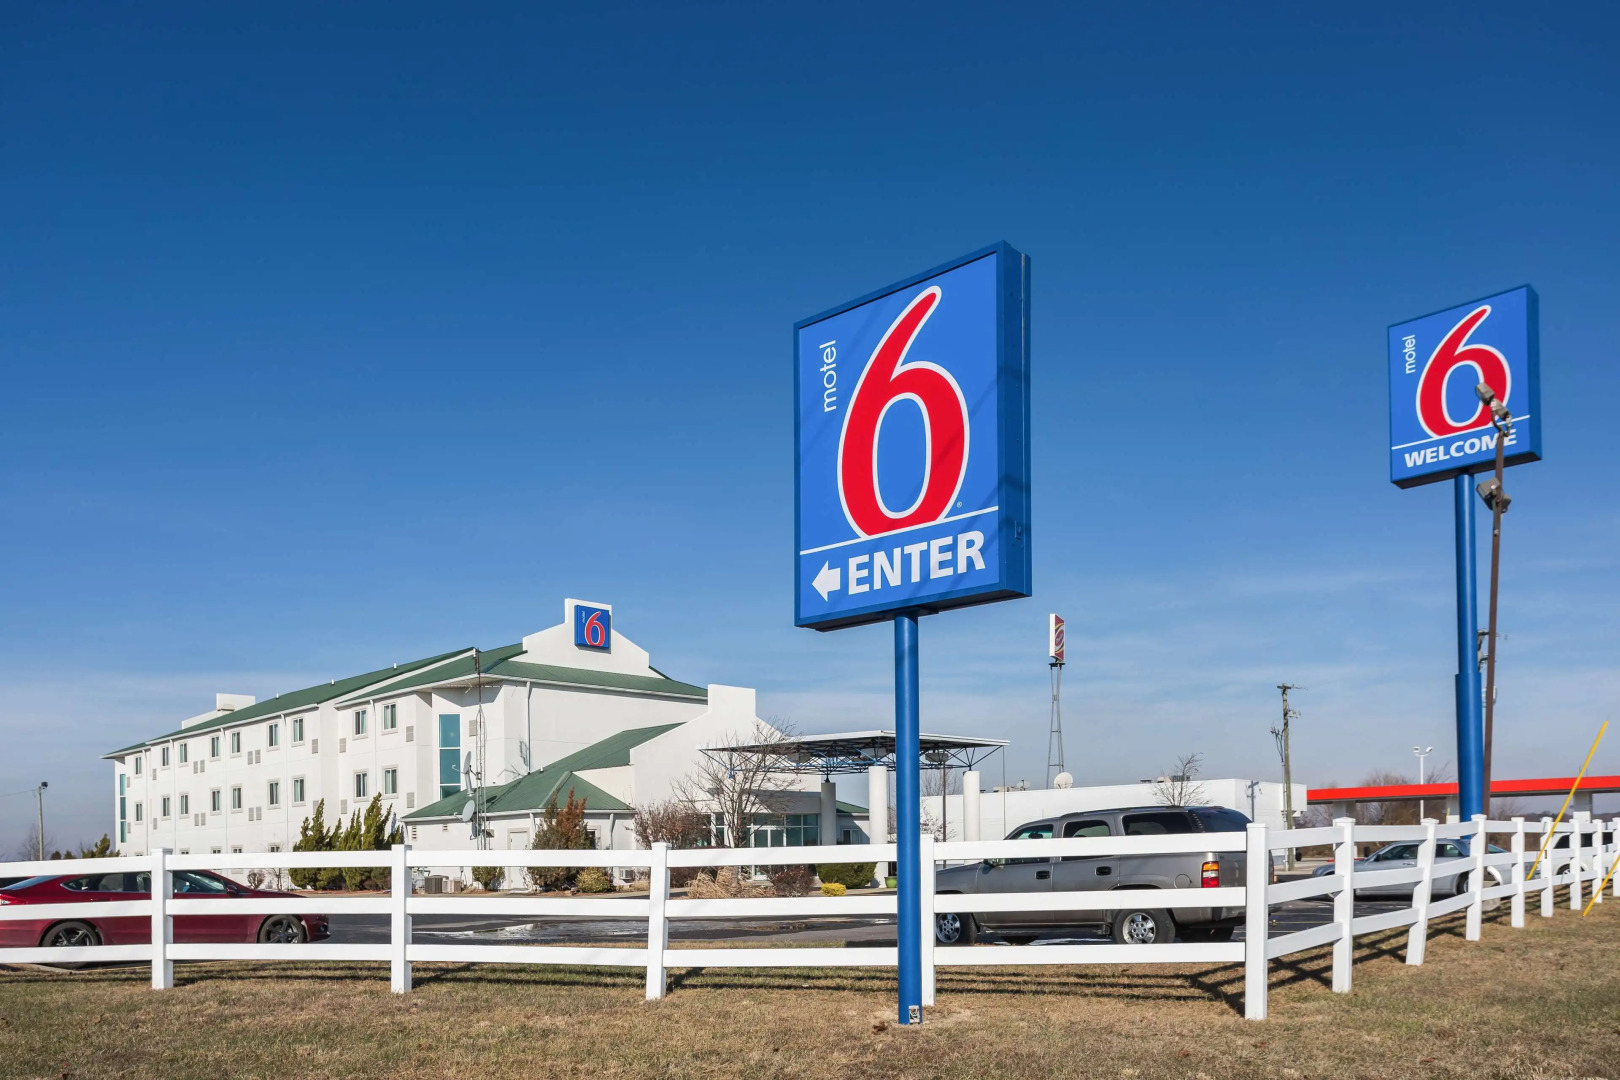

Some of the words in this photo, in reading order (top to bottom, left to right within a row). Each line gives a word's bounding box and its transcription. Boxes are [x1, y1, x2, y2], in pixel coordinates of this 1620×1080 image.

[819, 340, 836, 412] motel
[1402, 335, 1416, 374] motel
[1416, 305, 1511, 438] 6
[837, 285, 970, 537] 6
[1404, 429, 1517, 468] WELCOME
[848, 530, 985, 595] ENTER
[585, 611, 605, 646] 6
